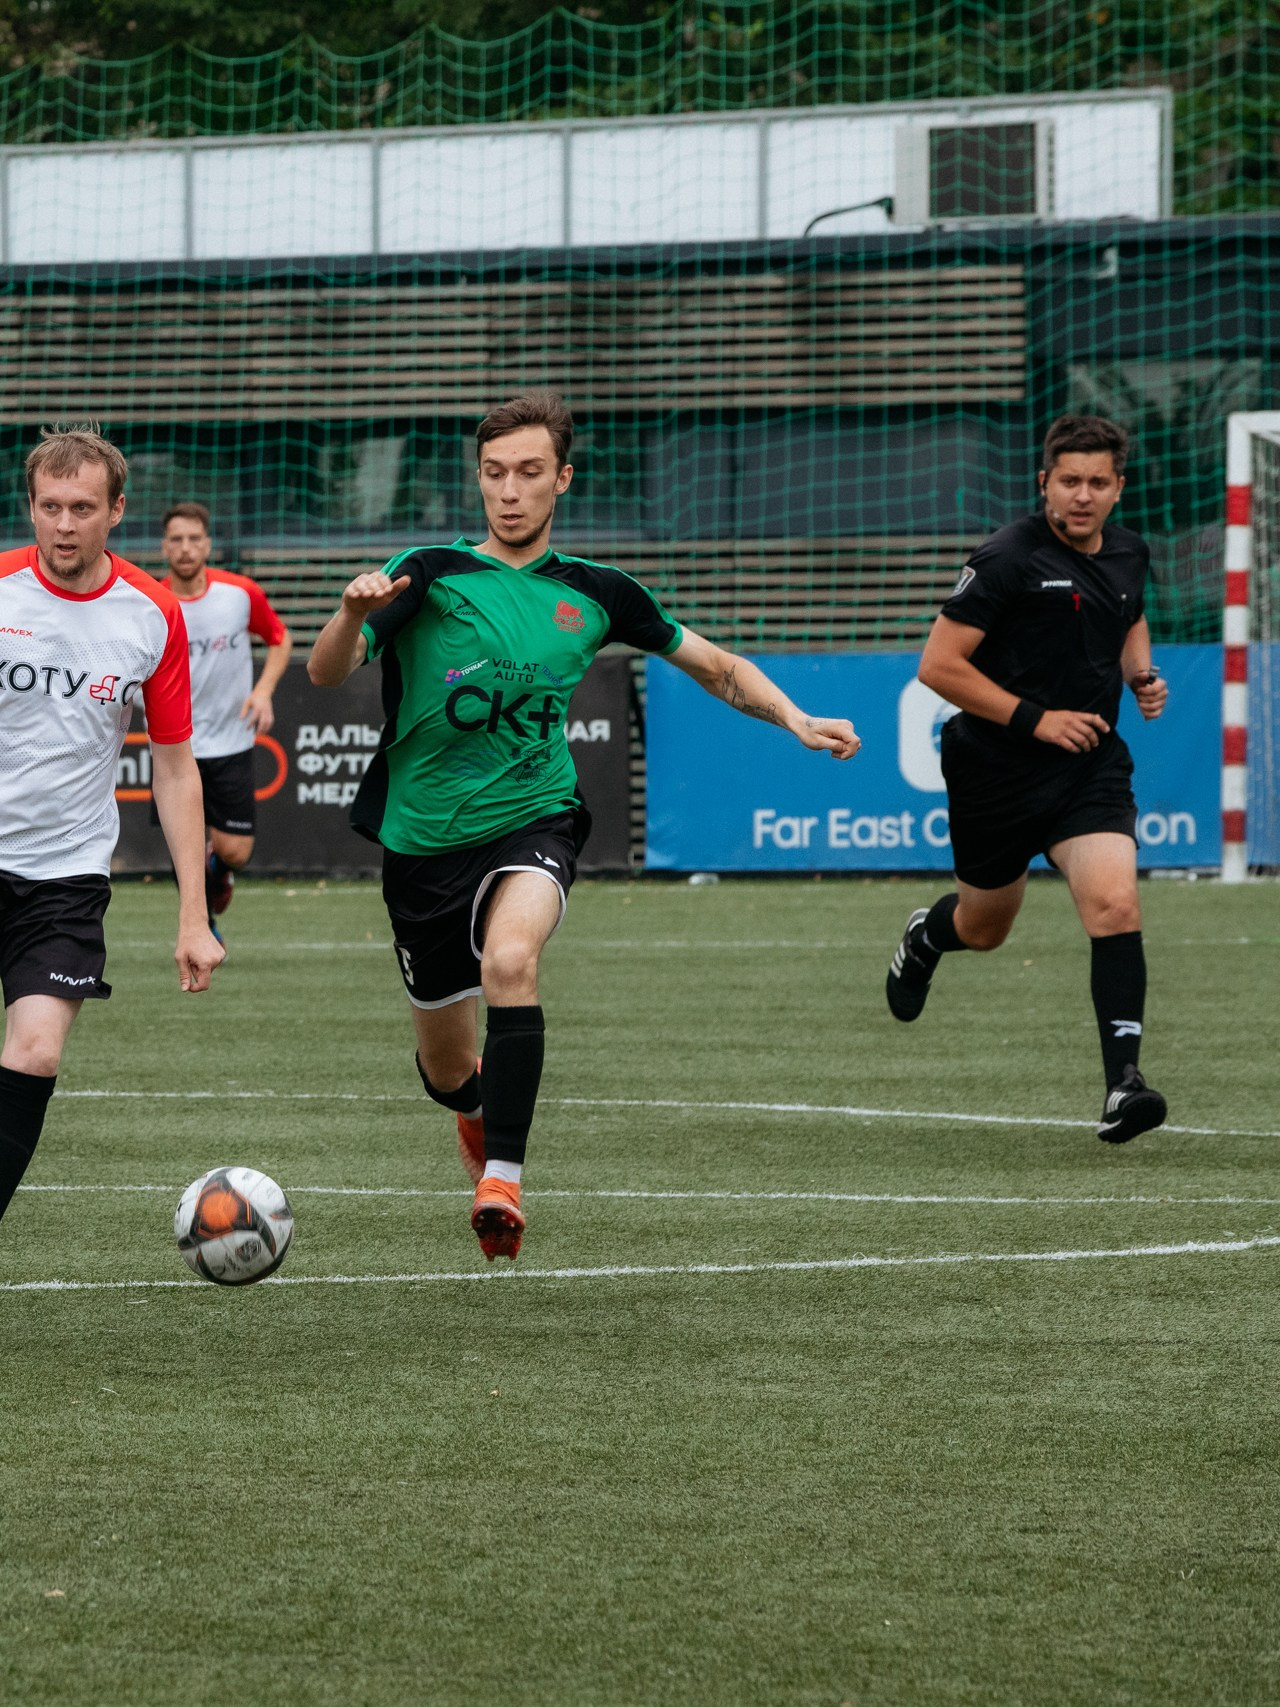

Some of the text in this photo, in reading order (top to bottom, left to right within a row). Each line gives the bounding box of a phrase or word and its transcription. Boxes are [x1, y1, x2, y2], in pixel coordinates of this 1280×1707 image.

[492, 657, 540, 673] VOLAT
[493, 670, 534, 684] AUTO
[753, 808, 819, 849] Far
[828, 808, 916, 849] East
[50, 972, 97, 986] MAVEX
